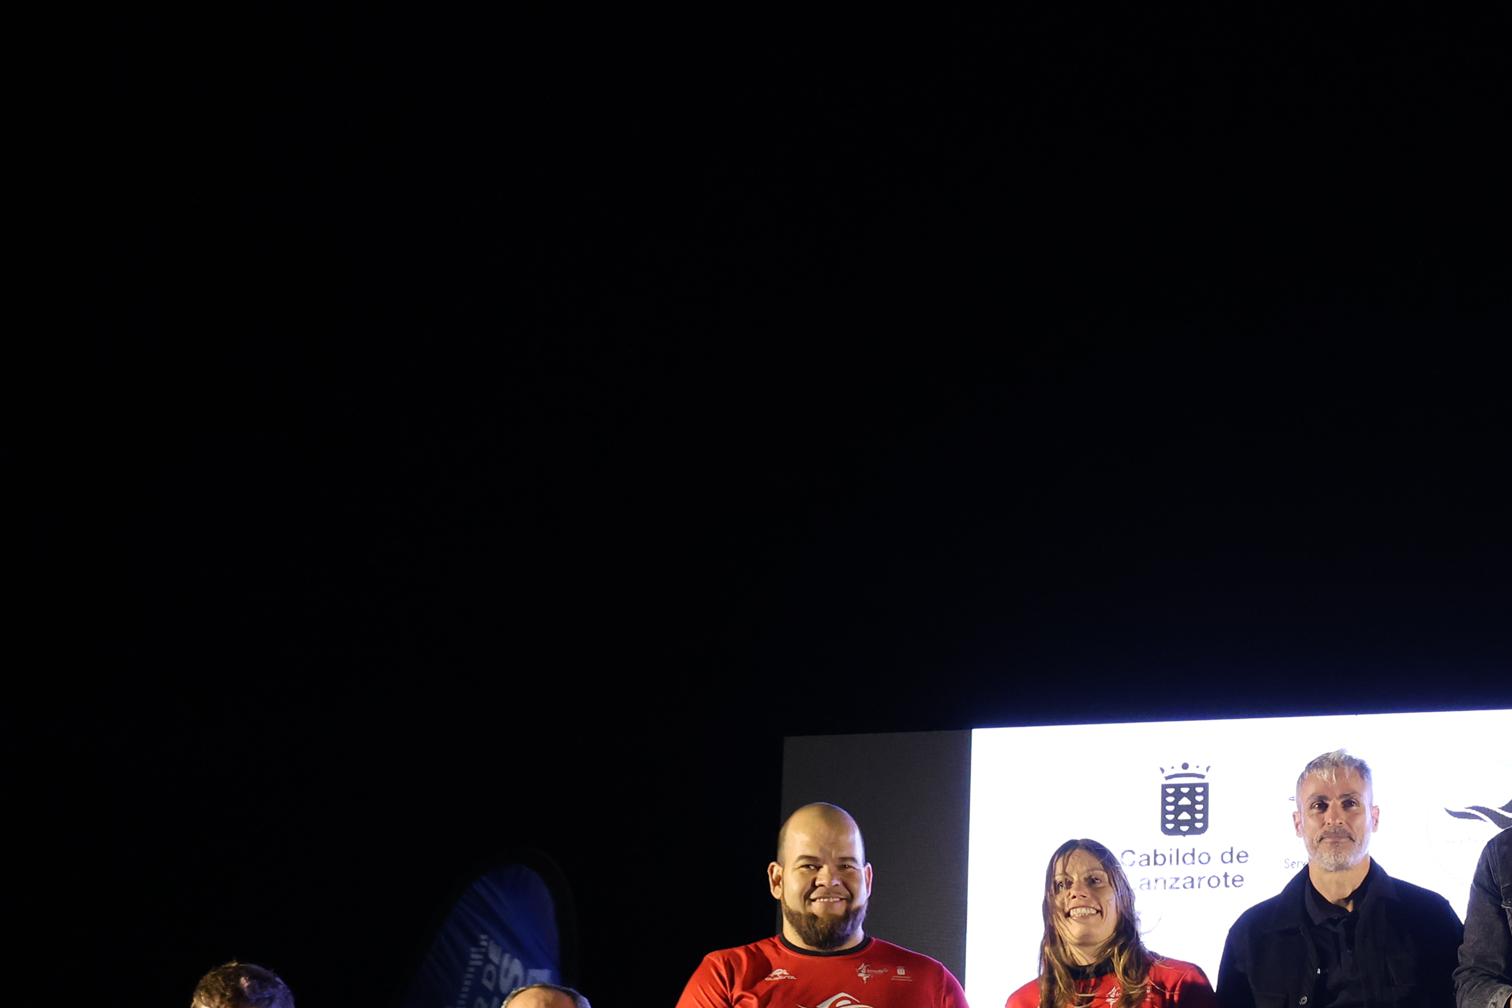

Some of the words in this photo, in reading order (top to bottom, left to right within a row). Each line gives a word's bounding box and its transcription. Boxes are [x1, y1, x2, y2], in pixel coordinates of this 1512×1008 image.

[1120, 848, 1211, 867] Cabildo
[1220, 846, 1249, 864] de
[1136, 872, 1244, 891] anzarote
